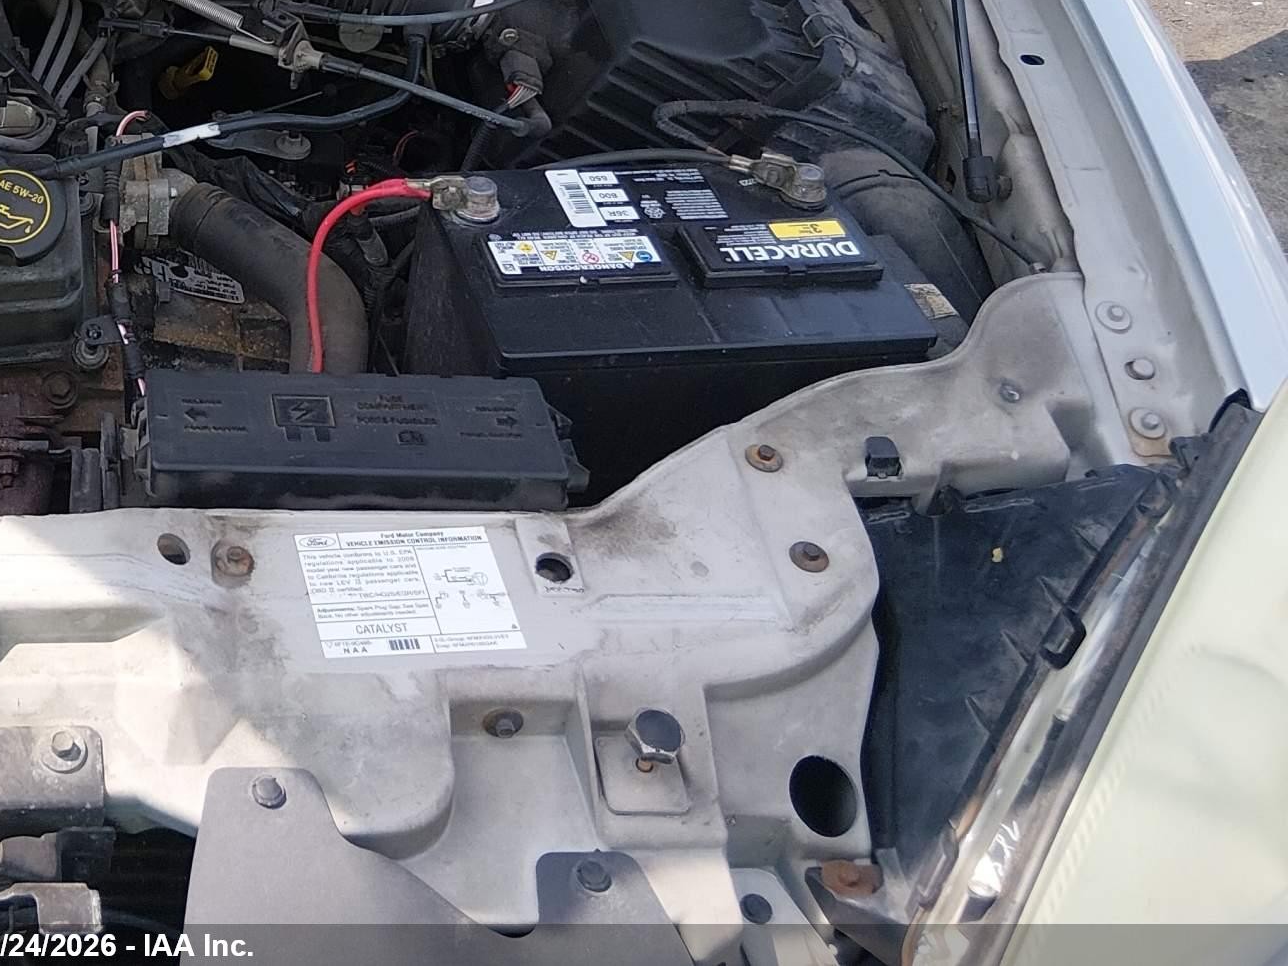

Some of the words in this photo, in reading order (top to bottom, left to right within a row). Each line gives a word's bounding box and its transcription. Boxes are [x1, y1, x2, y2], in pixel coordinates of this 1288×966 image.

[12, 185, 44, 204] 5W-20
[719, 240, 861, 262] DURACELL
[306, 537, 328, 547] Ford
[346, 539, 373, 547] VEHICLE
[374, 538, 406, 546] EMISSION
[438, 535, 483, 543] INFORMATION
[355, 622, 408, 635] CATALYST
